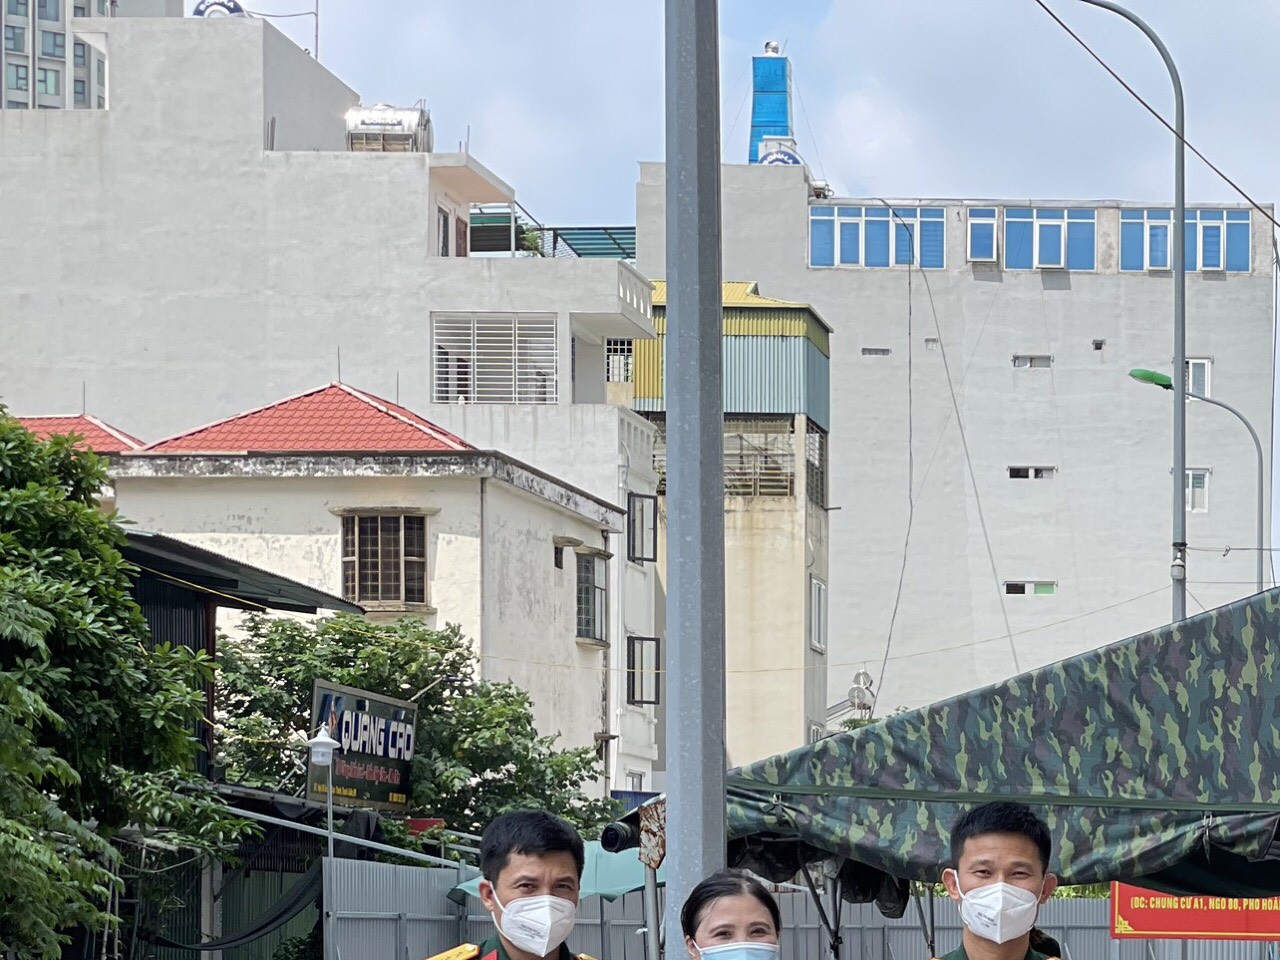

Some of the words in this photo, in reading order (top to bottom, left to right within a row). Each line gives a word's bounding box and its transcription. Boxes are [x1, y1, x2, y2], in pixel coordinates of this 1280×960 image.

[341, 699, 386, 756] QUẢNG
[388, 710, 414, 761] CÁO
[1149, 897, 1179, 910] CHUNG
[1193, 898, 1207, 911] A1,
[1227, 898, 1242, 911] 80,
